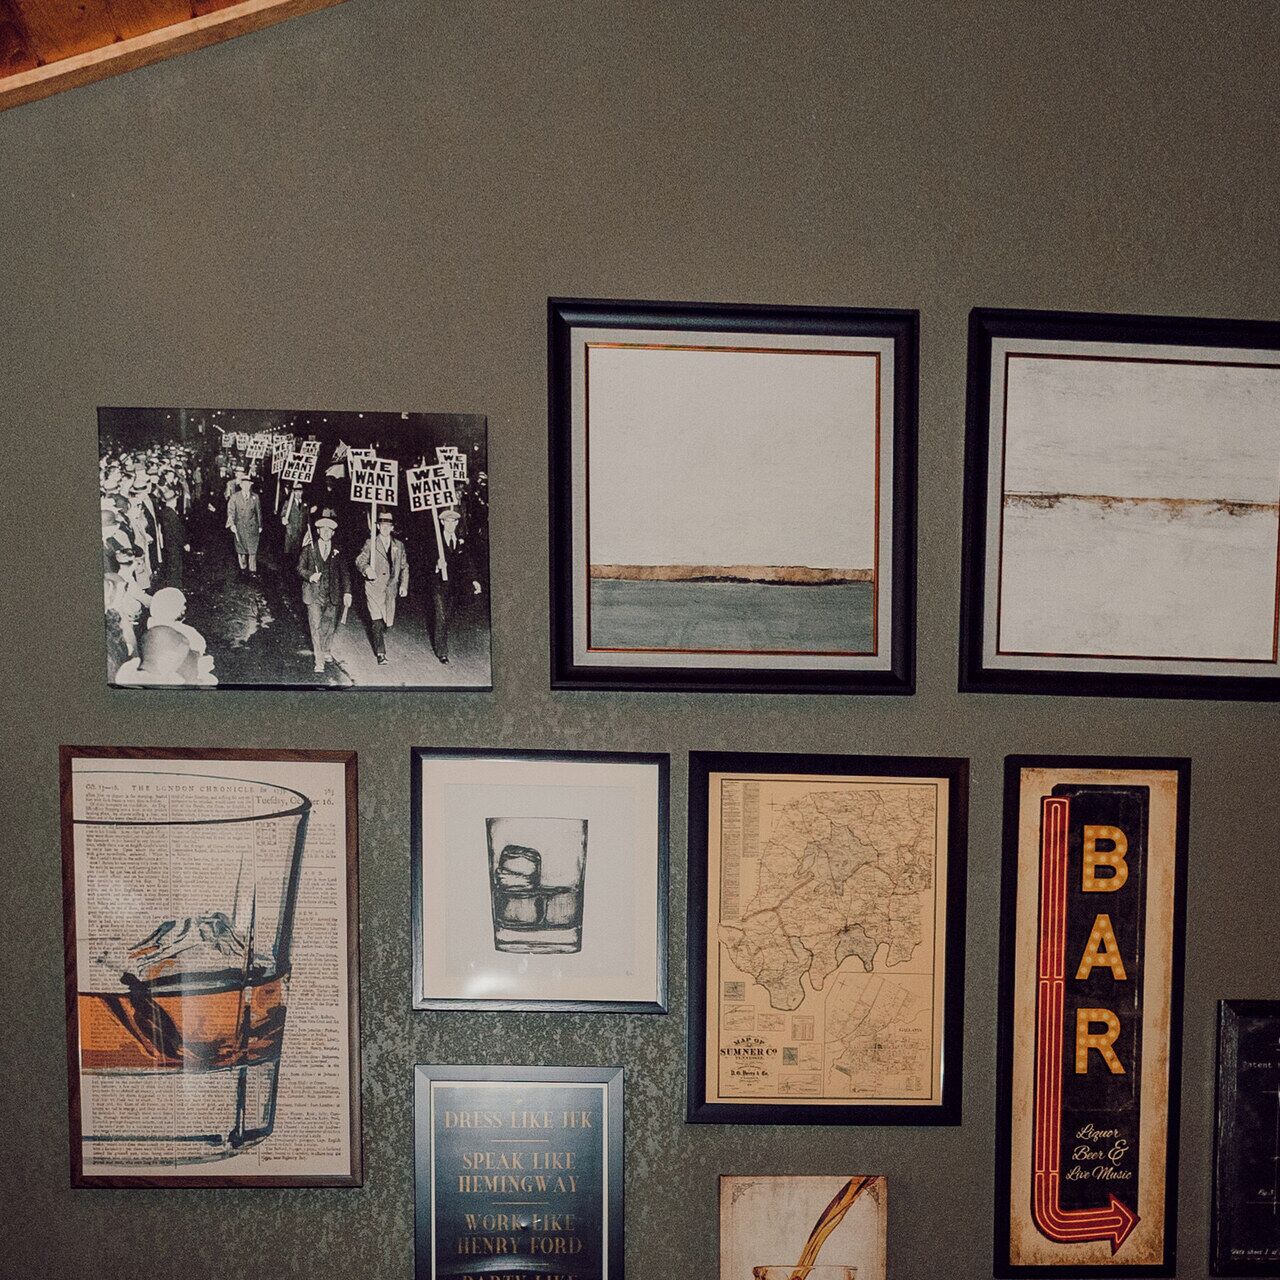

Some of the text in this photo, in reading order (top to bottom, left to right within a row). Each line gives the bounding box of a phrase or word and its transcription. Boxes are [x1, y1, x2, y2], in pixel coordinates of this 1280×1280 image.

[287, 461, 314, 472] WANT
[292, 455, 314, 463] WE
[361, 459, 392, 473] WE
[284, 470, 312, 481] BEER
[355, 471, 395, 487] WANT
[413, 467, 445, 481] WE
[354, 485, 395, 503] BEER
[411, 477, 449, 495] WANT
[412, 491, 454, 509] BEER
[200, 785, 254, 793] CHRONICLE
[1074, 824, 1130, 1076] BAR
[719, 1048, 764, 1056] SUMNER
[444, 1111, 592, 1128] DRESS LIKE JFK
[1075, 1123, 1121, 1142] Liquor
[462, 1152, 576, 1170] SPEAK LIKE
[1072, 1139, 1130, 1167] Beer &
[1065, 1165, 1132, 1181] Live Music
[457, 1175, 579, 1193] HEMINGWAY
[465, 1214, 575, 1231] WORK LIKE
[457, 1237, 583, 1254] HENRY FORD
